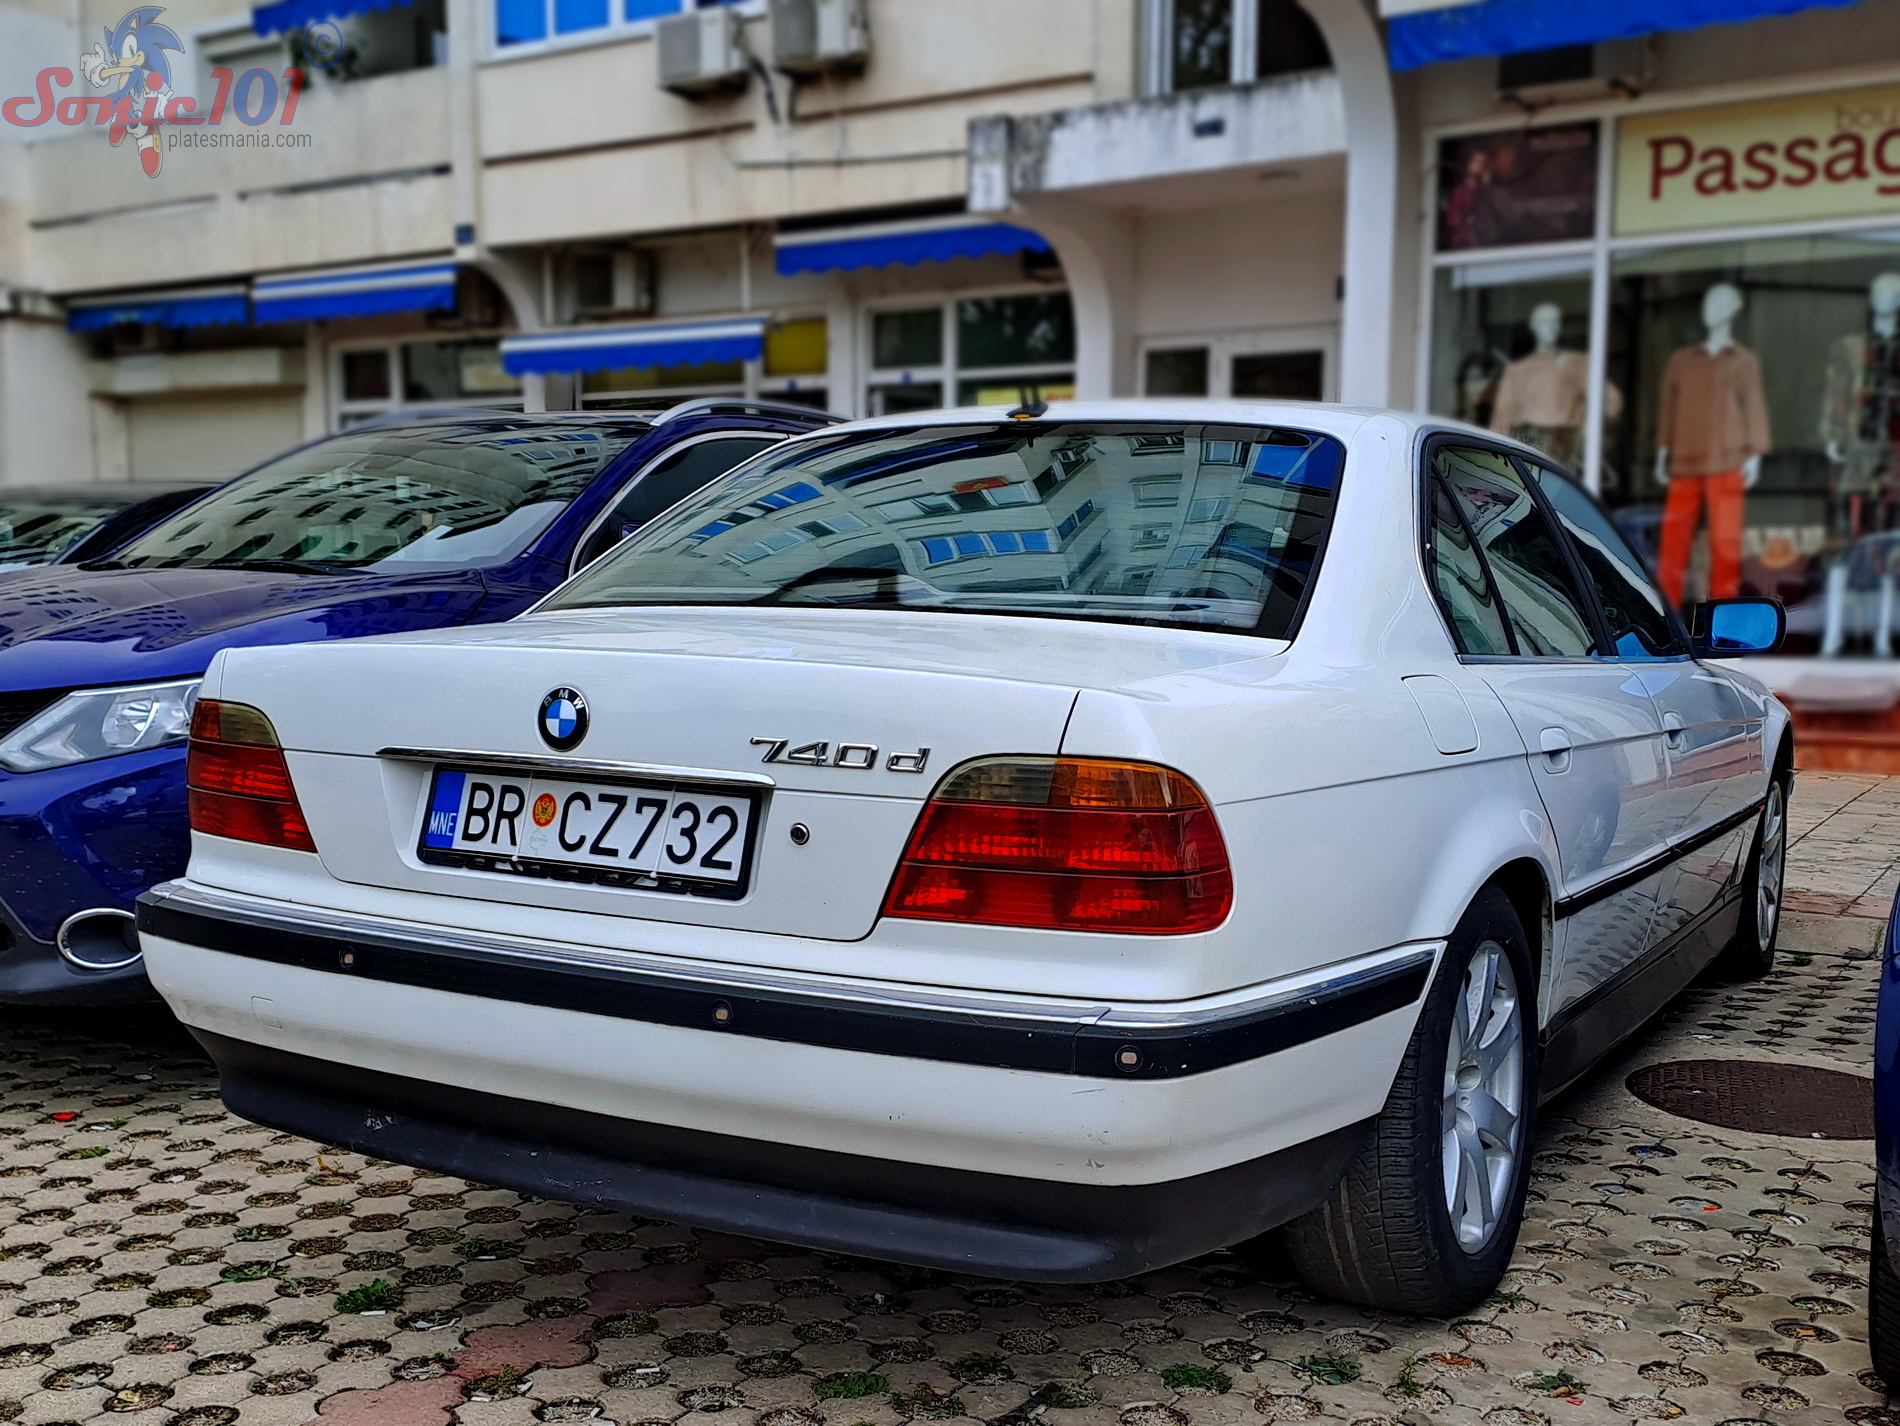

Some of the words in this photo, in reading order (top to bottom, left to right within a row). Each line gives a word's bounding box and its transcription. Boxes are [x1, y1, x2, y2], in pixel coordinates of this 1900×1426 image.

[543, 688, 585, 710] BMW
[428, 810, 458, 837] MNE
[461, 781, 526, 846] BR
[557, 790, 739, 871] CZ732
